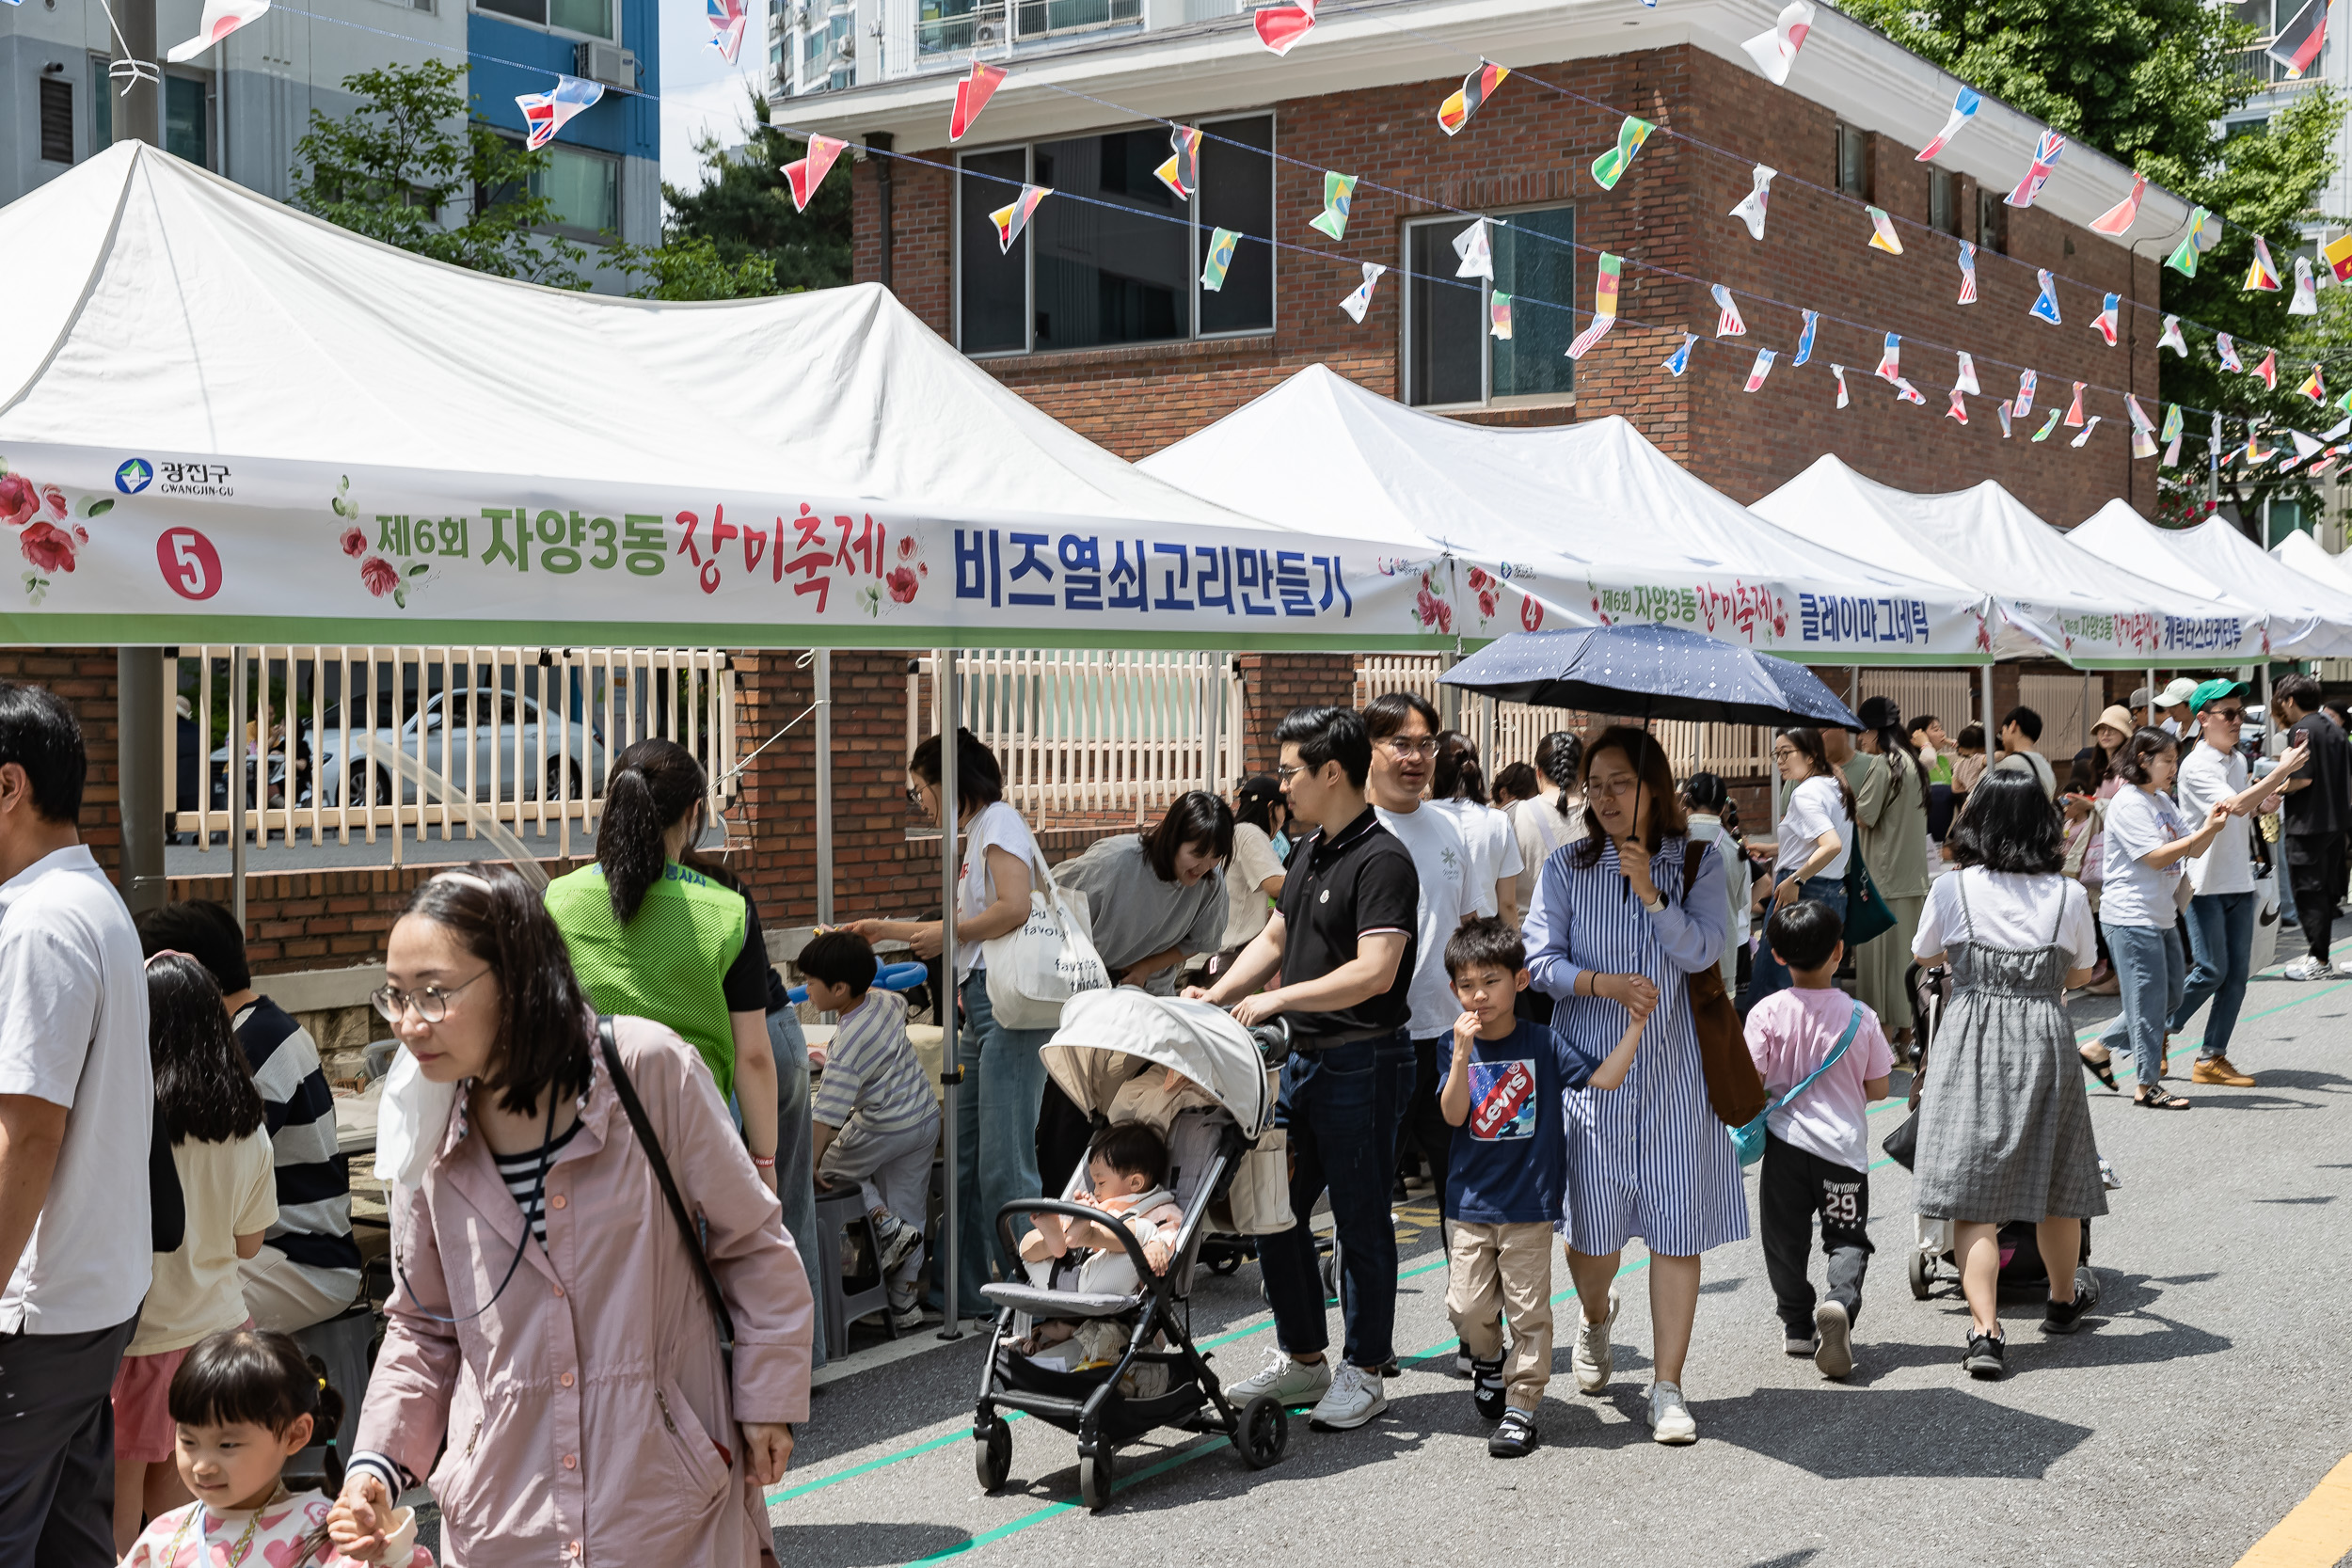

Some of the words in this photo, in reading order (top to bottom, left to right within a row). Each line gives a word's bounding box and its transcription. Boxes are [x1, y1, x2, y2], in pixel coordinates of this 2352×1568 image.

[161, 462, 231, 483] 광진구
[171, 534, 206, 596] 5
[376, 514, 469, 559] 제6회
[481, 507, 667, 576] 자양3동
[675, 502, 886, 614] 장미축제
[953, 528, 1354, 619] 비즈열쇠고리만들기
[1524, 594, 1538, 629] 4
[1602, 588, 1631, 614] 제6회
[1633, 584, 1697, 624] 자양3동
[1696, 578, 1772, 644] 장미축제
[1799, 593, 1929, 644] 클레이마그네틱
[1825, 1192, 1857, 1221] 29
